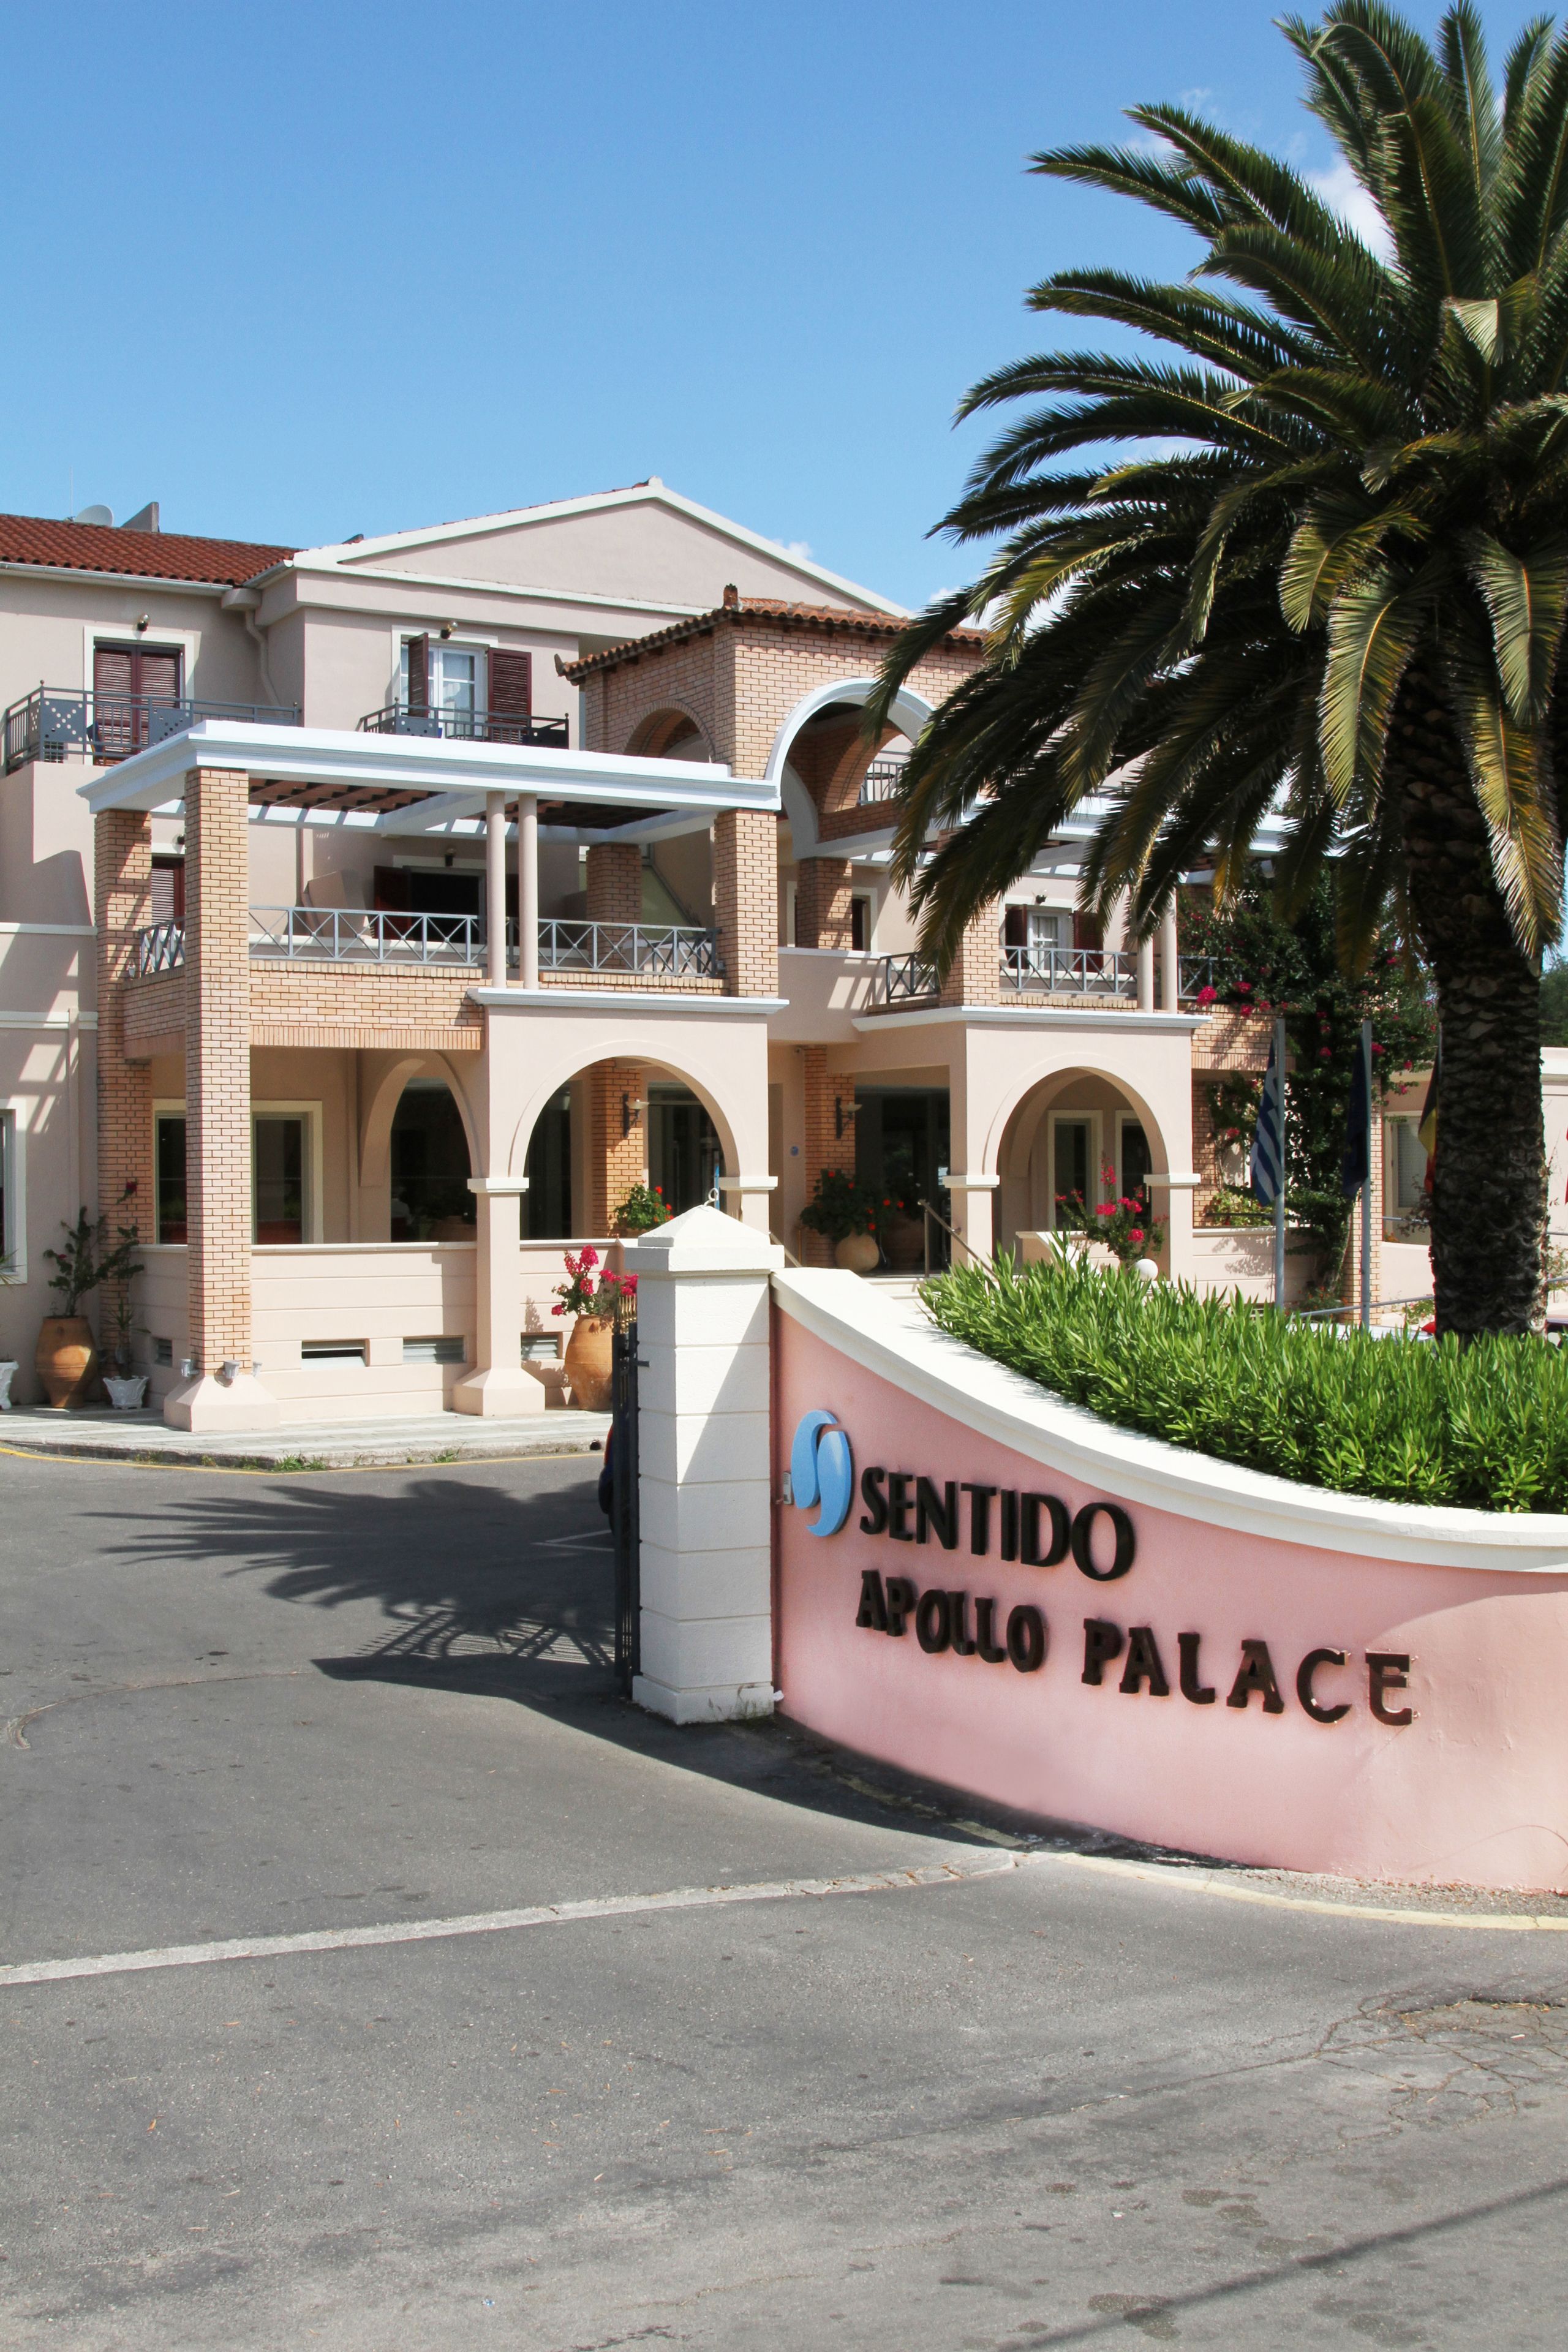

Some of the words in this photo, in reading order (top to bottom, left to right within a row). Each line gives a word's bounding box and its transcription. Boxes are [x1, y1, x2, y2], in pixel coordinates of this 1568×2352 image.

[859, 1466, 1136, 1581] SENTIDO
[856, 1569, 1047, 1673] APOLLO
[1080, 1618, 1414, 1727] PALACE
